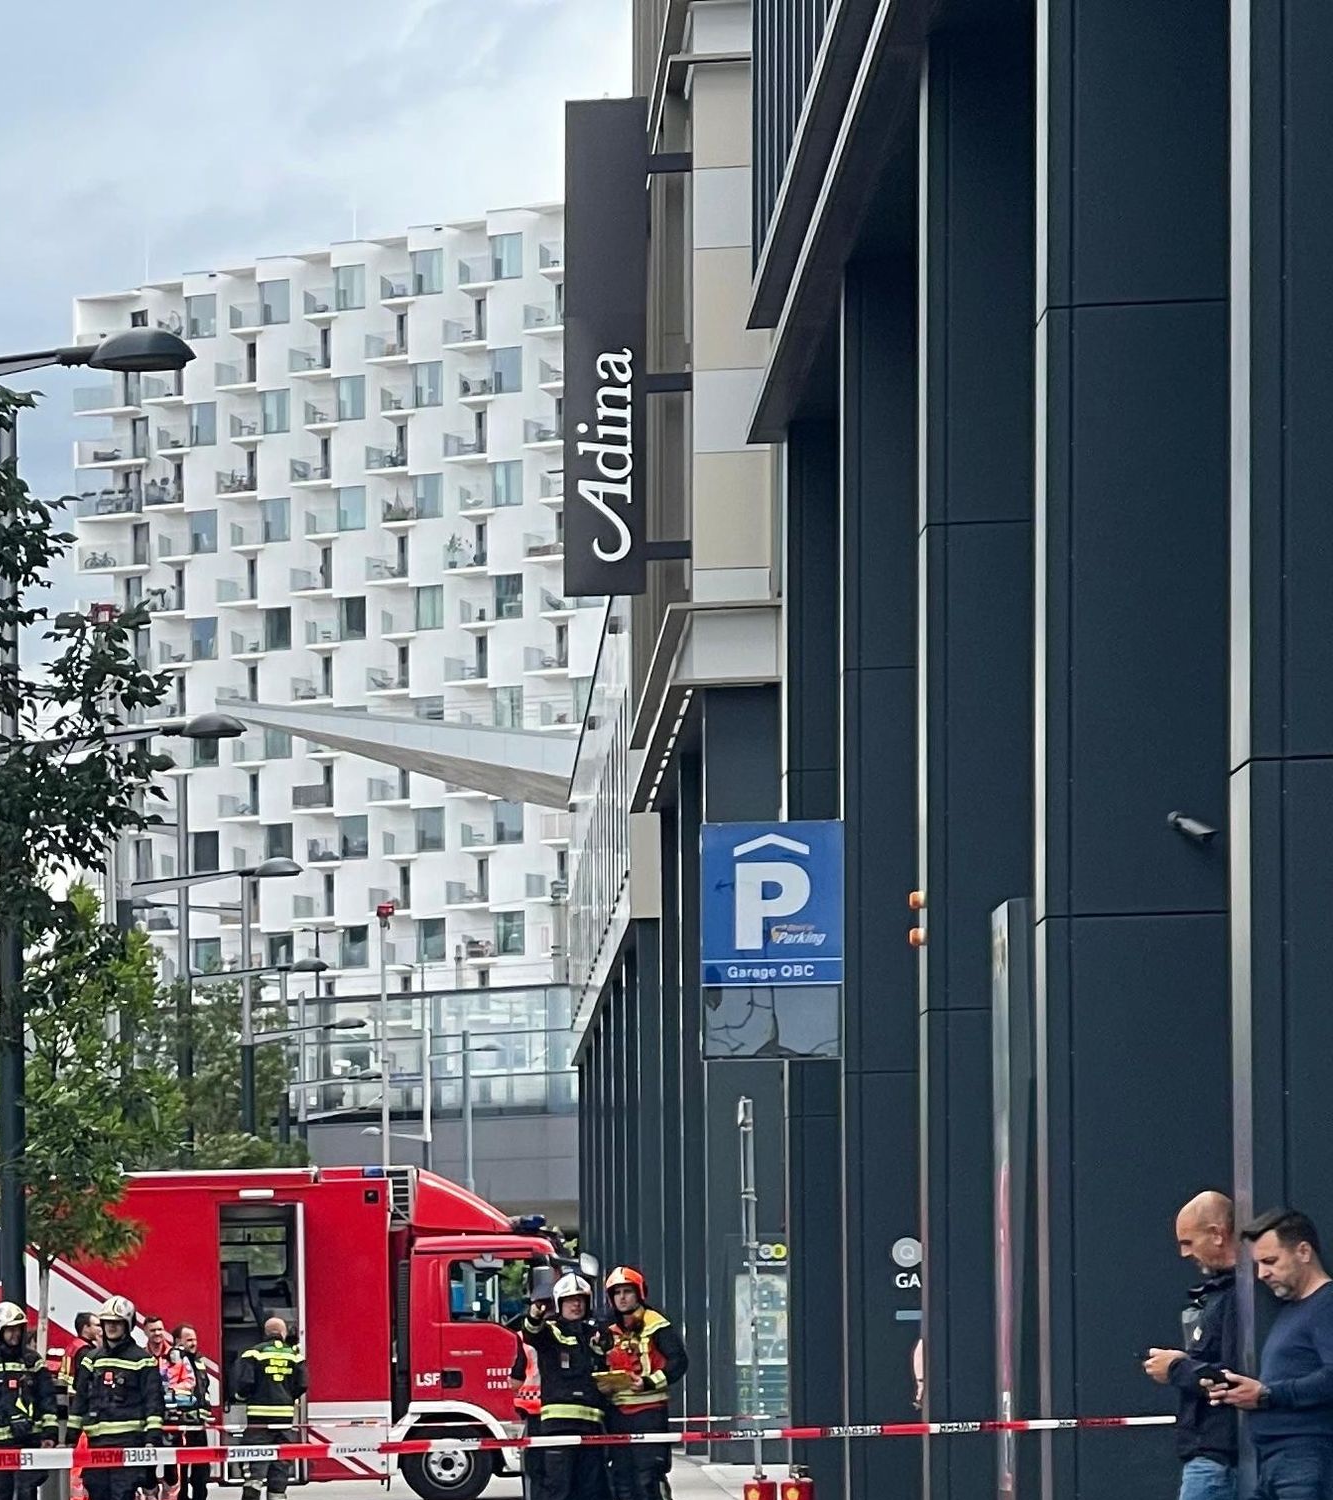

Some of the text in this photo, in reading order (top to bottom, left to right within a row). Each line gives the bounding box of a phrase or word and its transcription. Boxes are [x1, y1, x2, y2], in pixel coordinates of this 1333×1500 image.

[577, 348, 633, 562] Adina
[727, 966, 778, 980] Garage
[416, 1372, 441, 1387] LSF
